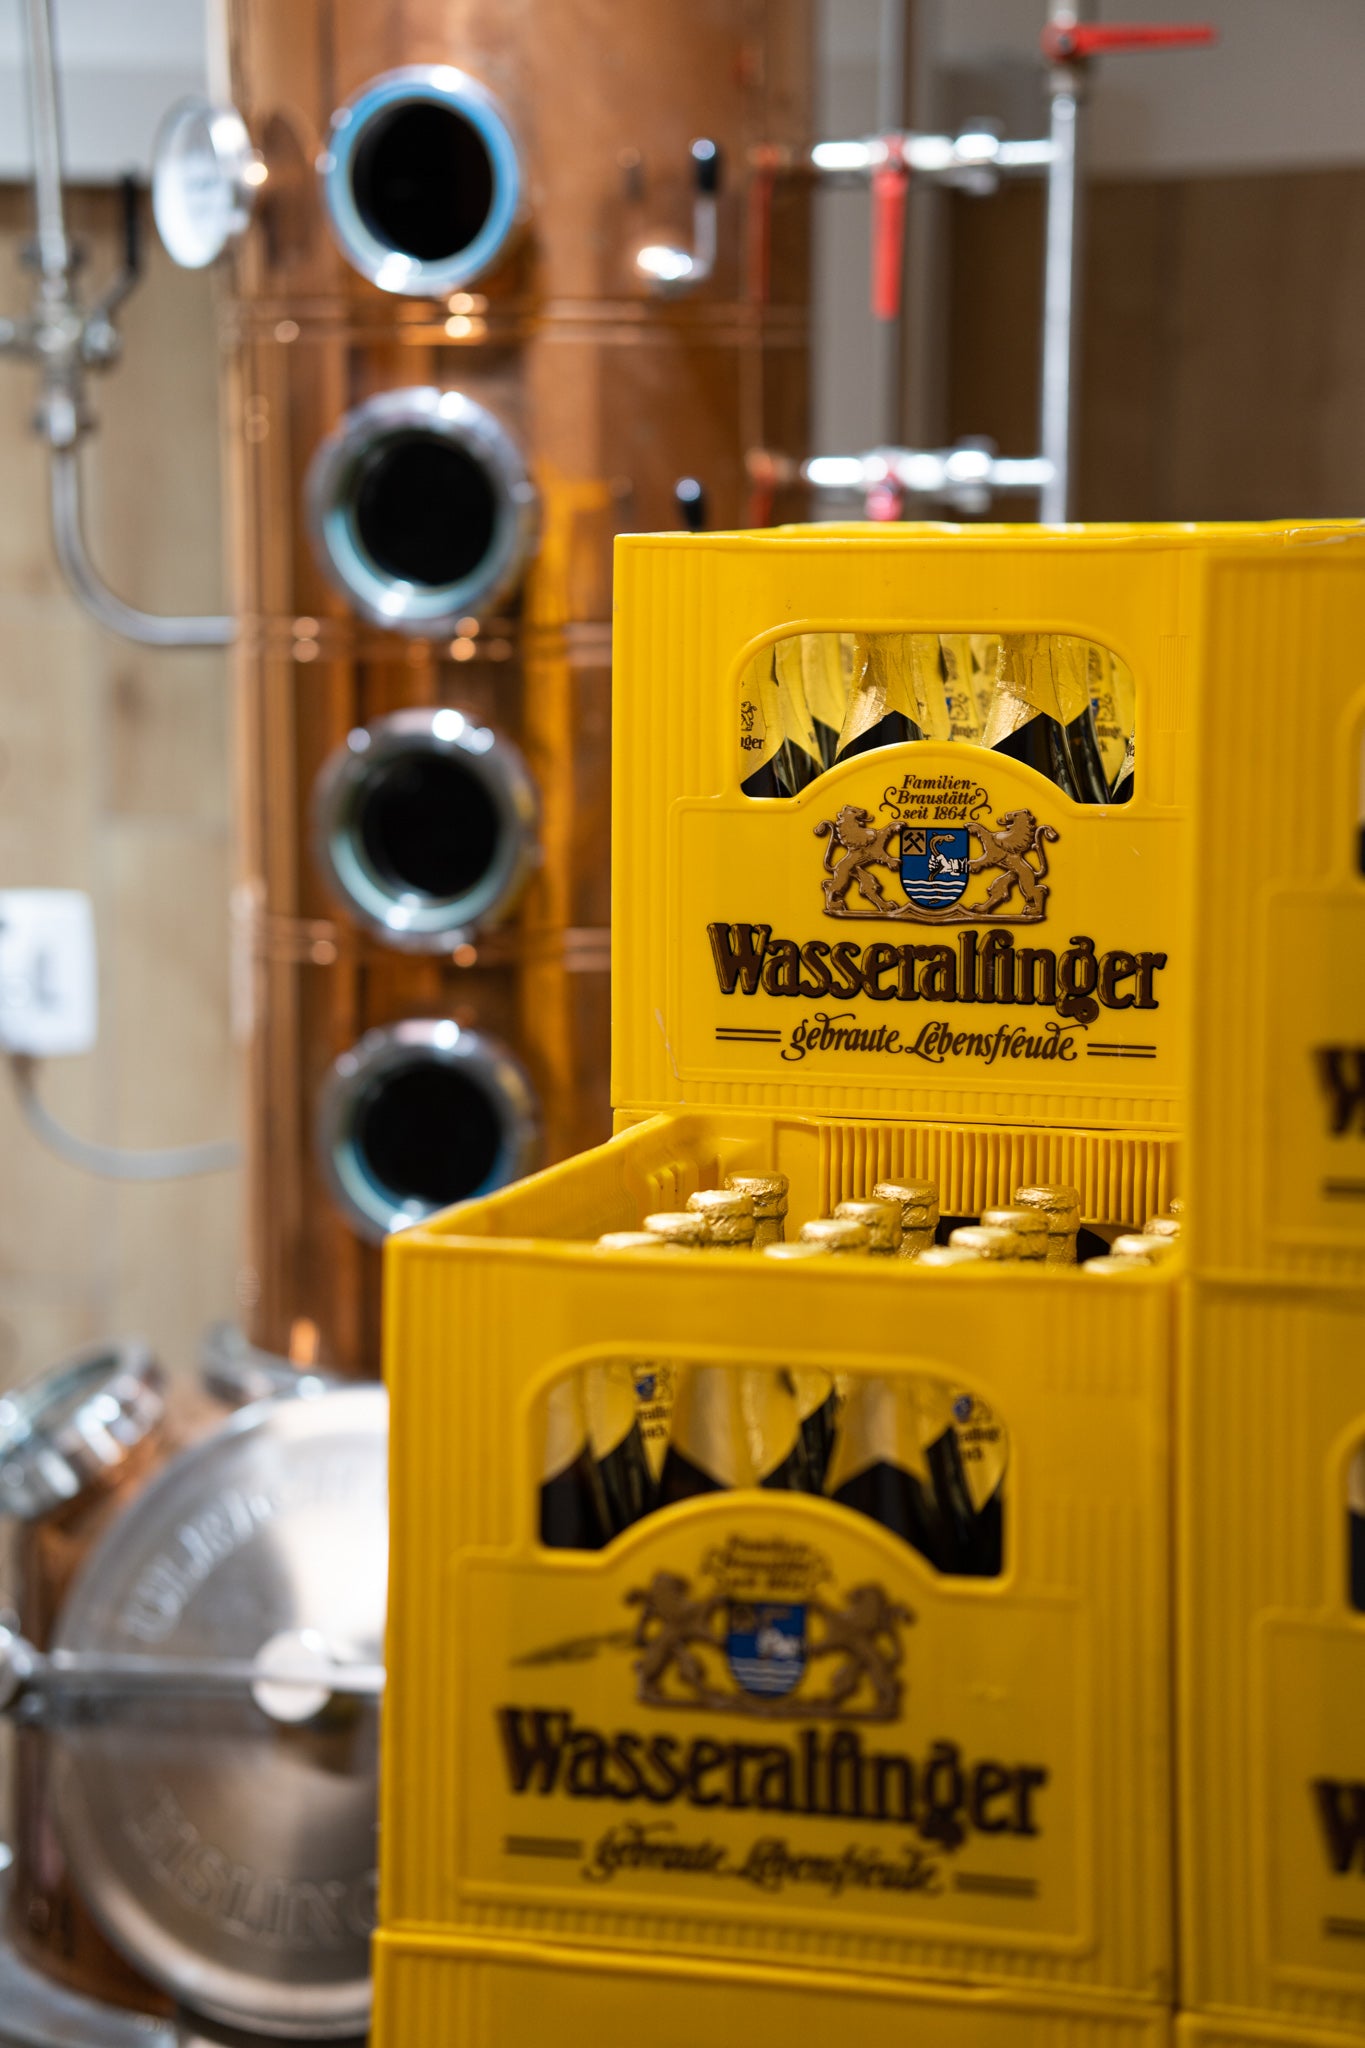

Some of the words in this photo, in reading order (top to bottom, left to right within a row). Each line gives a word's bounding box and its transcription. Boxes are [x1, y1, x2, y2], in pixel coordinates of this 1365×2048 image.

[897, 789, 977, 806] Braustätte
[902, 774, 977, 790] Familien-
[902, 806, 929, 820] seit
[933, 806, 968, 821] 1864
[707, 923, 1167, 1023] Wasseralfinger
[781, 1013, 903, 1062] gebraute
[904, 1021, 1088, 1065] Lebensfreude
[496, 1704, 1050, 1851] Wasseralfinger
